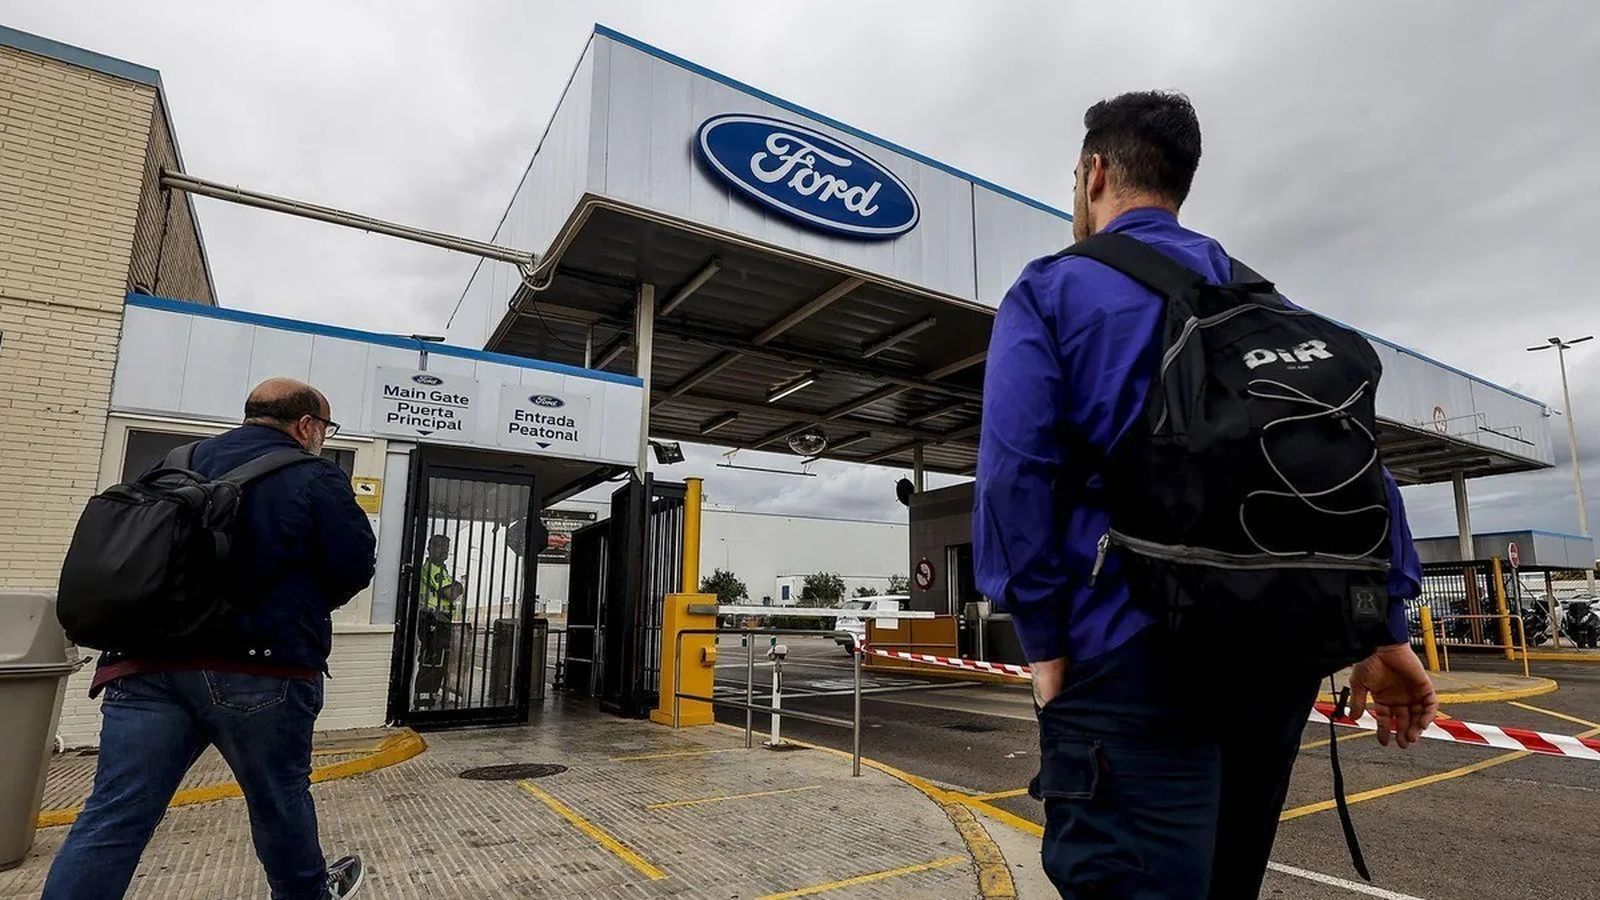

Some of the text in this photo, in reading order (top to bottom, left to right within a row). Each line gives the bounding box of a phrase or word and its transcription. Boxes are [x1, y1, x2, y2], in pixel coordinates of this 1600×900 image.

[750, 132, 882, 217] Ford
[384, 385, 469, 405] Main Gate
[398, 402, 454, 418] Puerta
[514, 409, 575, 428] Entrada
[387, 413, 462, 431] Principal
[509, 423, 578, 441] Peatonal
